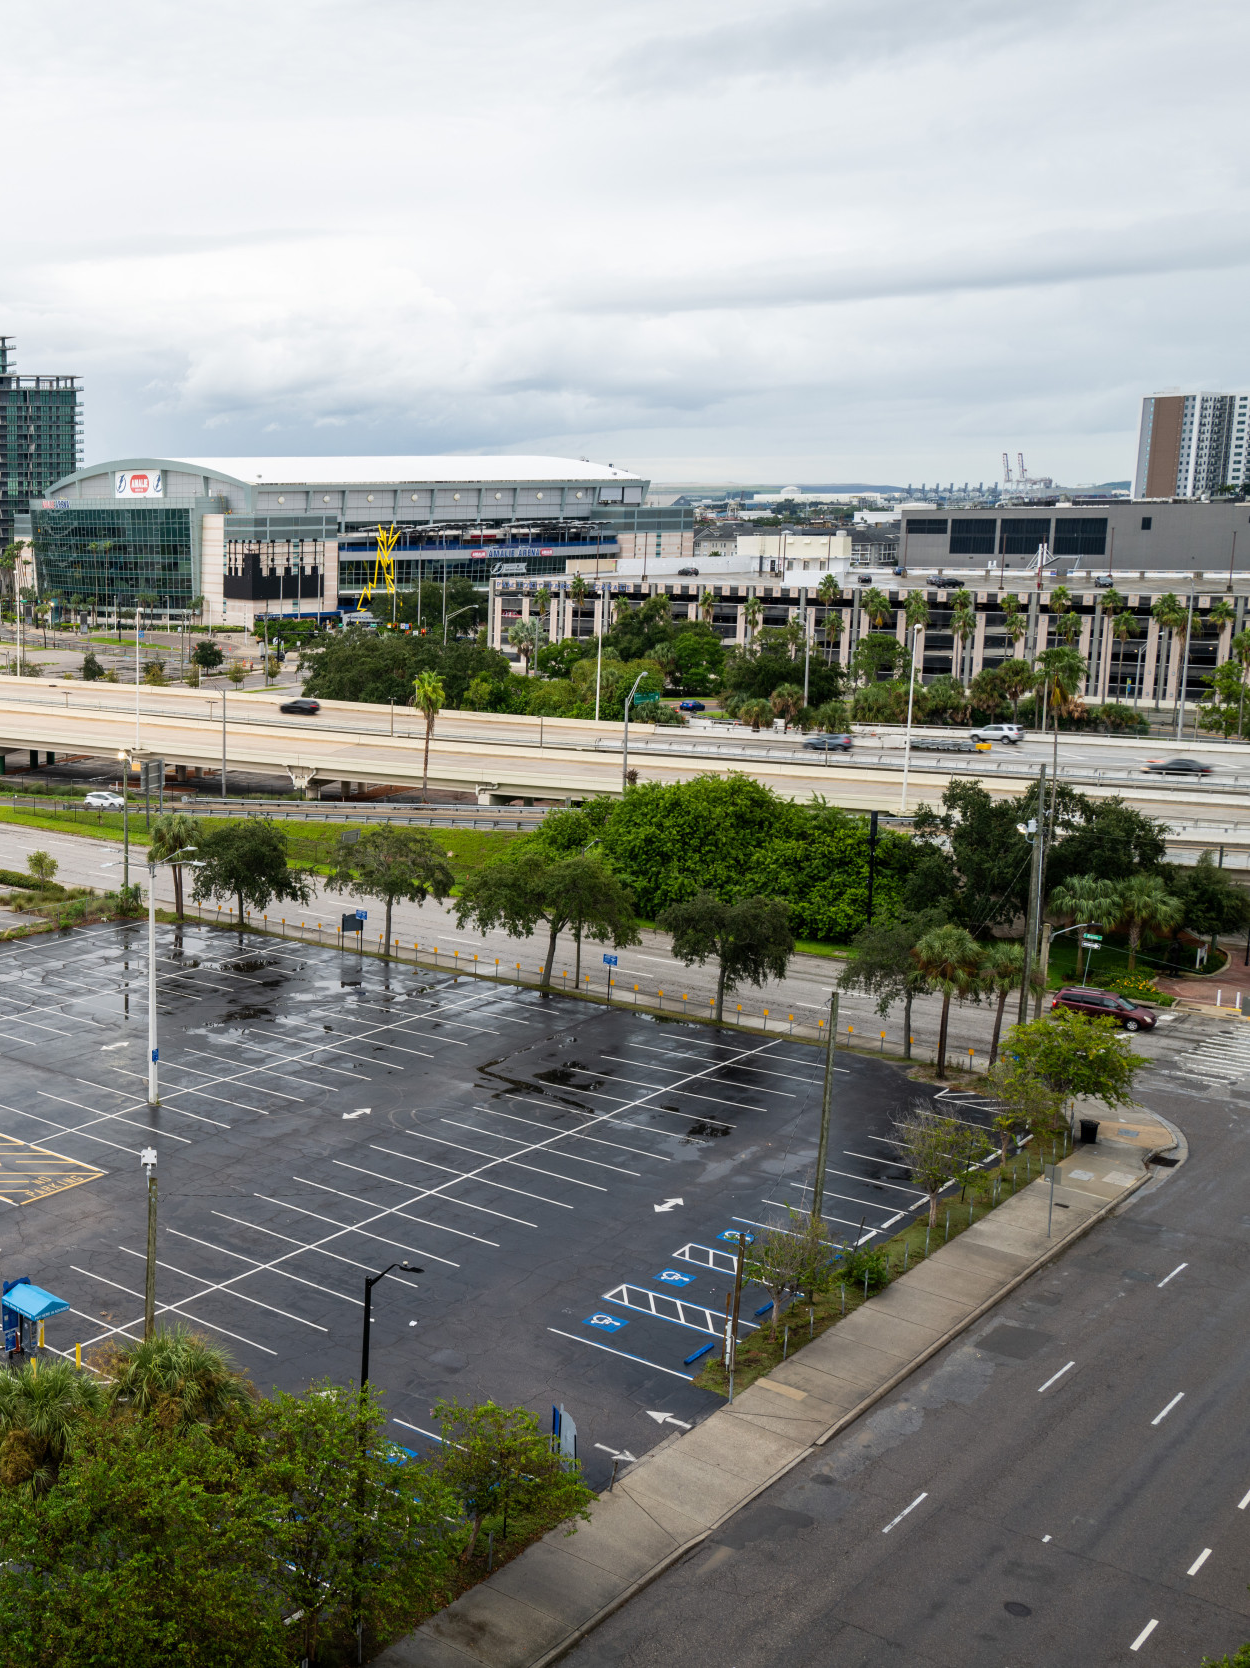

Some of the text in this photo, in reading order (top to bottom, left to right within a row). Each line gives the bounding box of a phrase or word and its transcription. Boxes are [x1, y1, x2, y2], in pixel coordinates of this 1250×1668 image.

[488, 548, 540, 558] AMALIE ARENA
[593, 583, 632, 592] GARAGE
[31, 1176, 53, 1186] NO
[24, 1175, 85, 1198] PARKING
